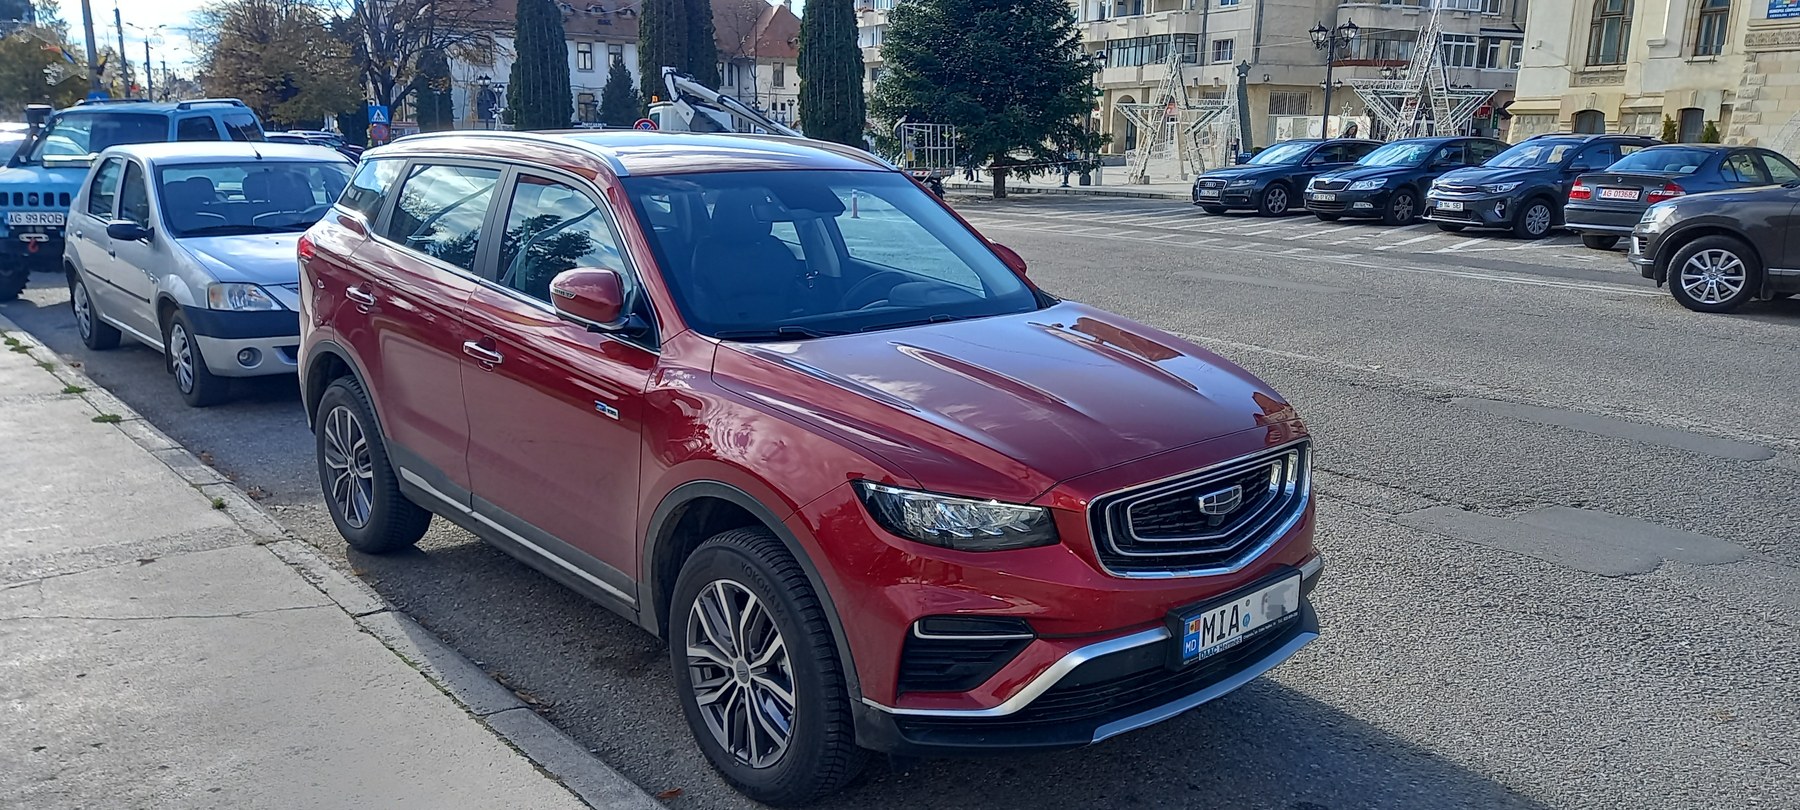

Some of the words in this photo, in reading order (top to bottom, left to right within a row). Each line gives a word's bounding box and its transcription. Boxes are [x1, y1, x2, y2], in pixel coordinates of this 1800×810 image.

[1603, 189, 1612, 197] AG
[10, 213, 22, 224] AG
[26, 213, 38, 224] 99
[40, 213, 63, 224] ROB
[1201, 604, 1240, 648] MIA
[1185, 639, 1197, 654] MD
[1218, 637, 1241, 653] Hermes
